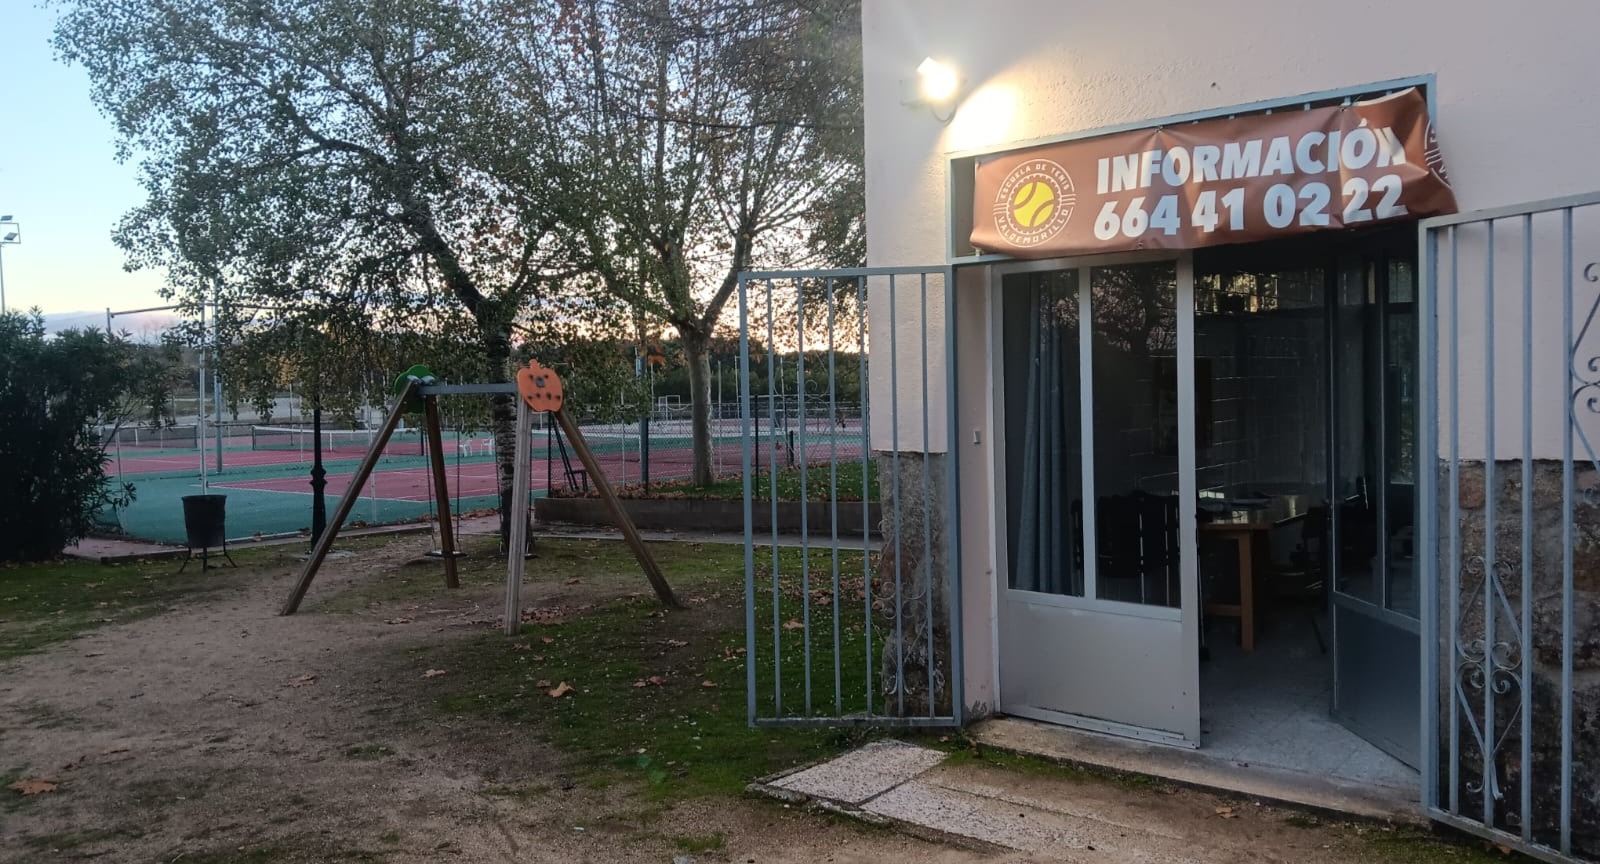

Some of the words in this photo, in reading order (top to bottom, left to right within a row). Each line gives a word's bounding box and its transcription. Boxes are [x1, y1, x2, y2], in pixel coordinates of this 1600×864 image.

[1000, 165, 1031, 199] ESCUELA
[1035, 163, 1048, 171] DE
[1051, 167, 1070, 190] TENIS
[1097, 118, 1406, 194] INFORMACIÓN
[998, 209, 1069, 244] VALDEMORILLO
[1094, 195, 1181, 241] 664
[1191, 187, 1245, 233] 41
[1263, 182, 1331, 229] 02
[1341, 174, 1409, 224] 22
